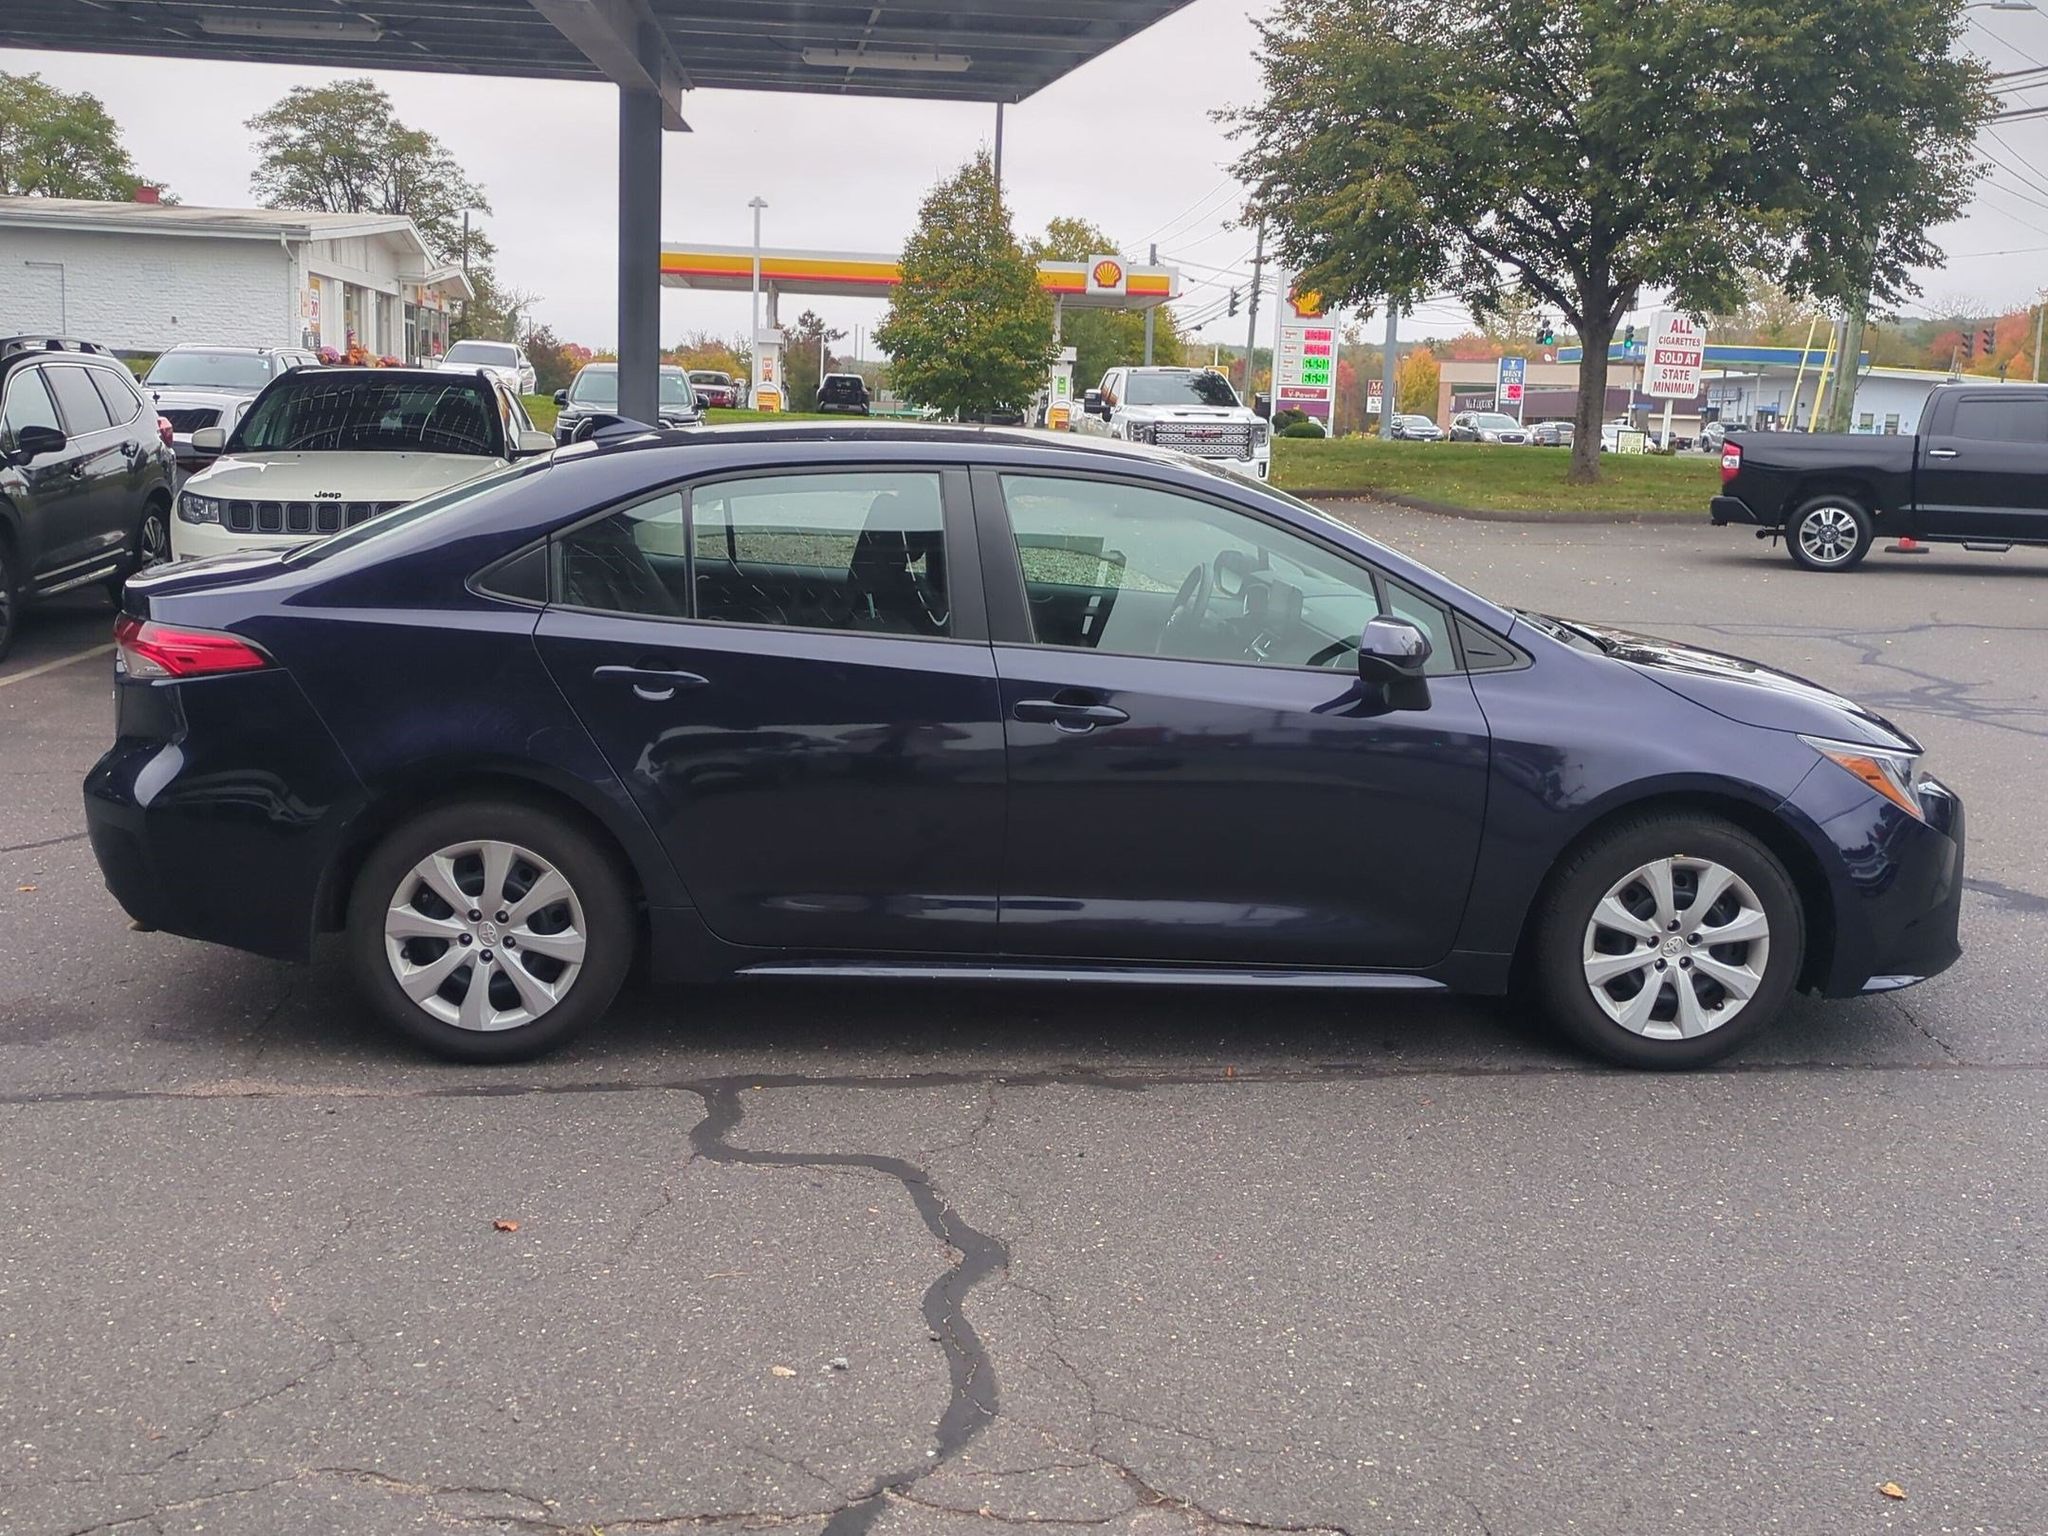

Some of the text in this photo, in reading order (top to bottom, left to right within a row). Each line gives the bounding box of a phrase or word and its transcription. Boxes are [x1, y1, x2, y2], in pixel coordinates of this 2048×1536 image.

[1670, 319, 1693, 334] ALL
[1658, 336, 1701, 347] CIGARETTES
[1658, 351, 1697, 365] SOLD AT
[1661, 368, 1690, 381] STATE
[1652, 381, 1695, 394] MINIMUM
[314, 490, 342, 499] Jeep
